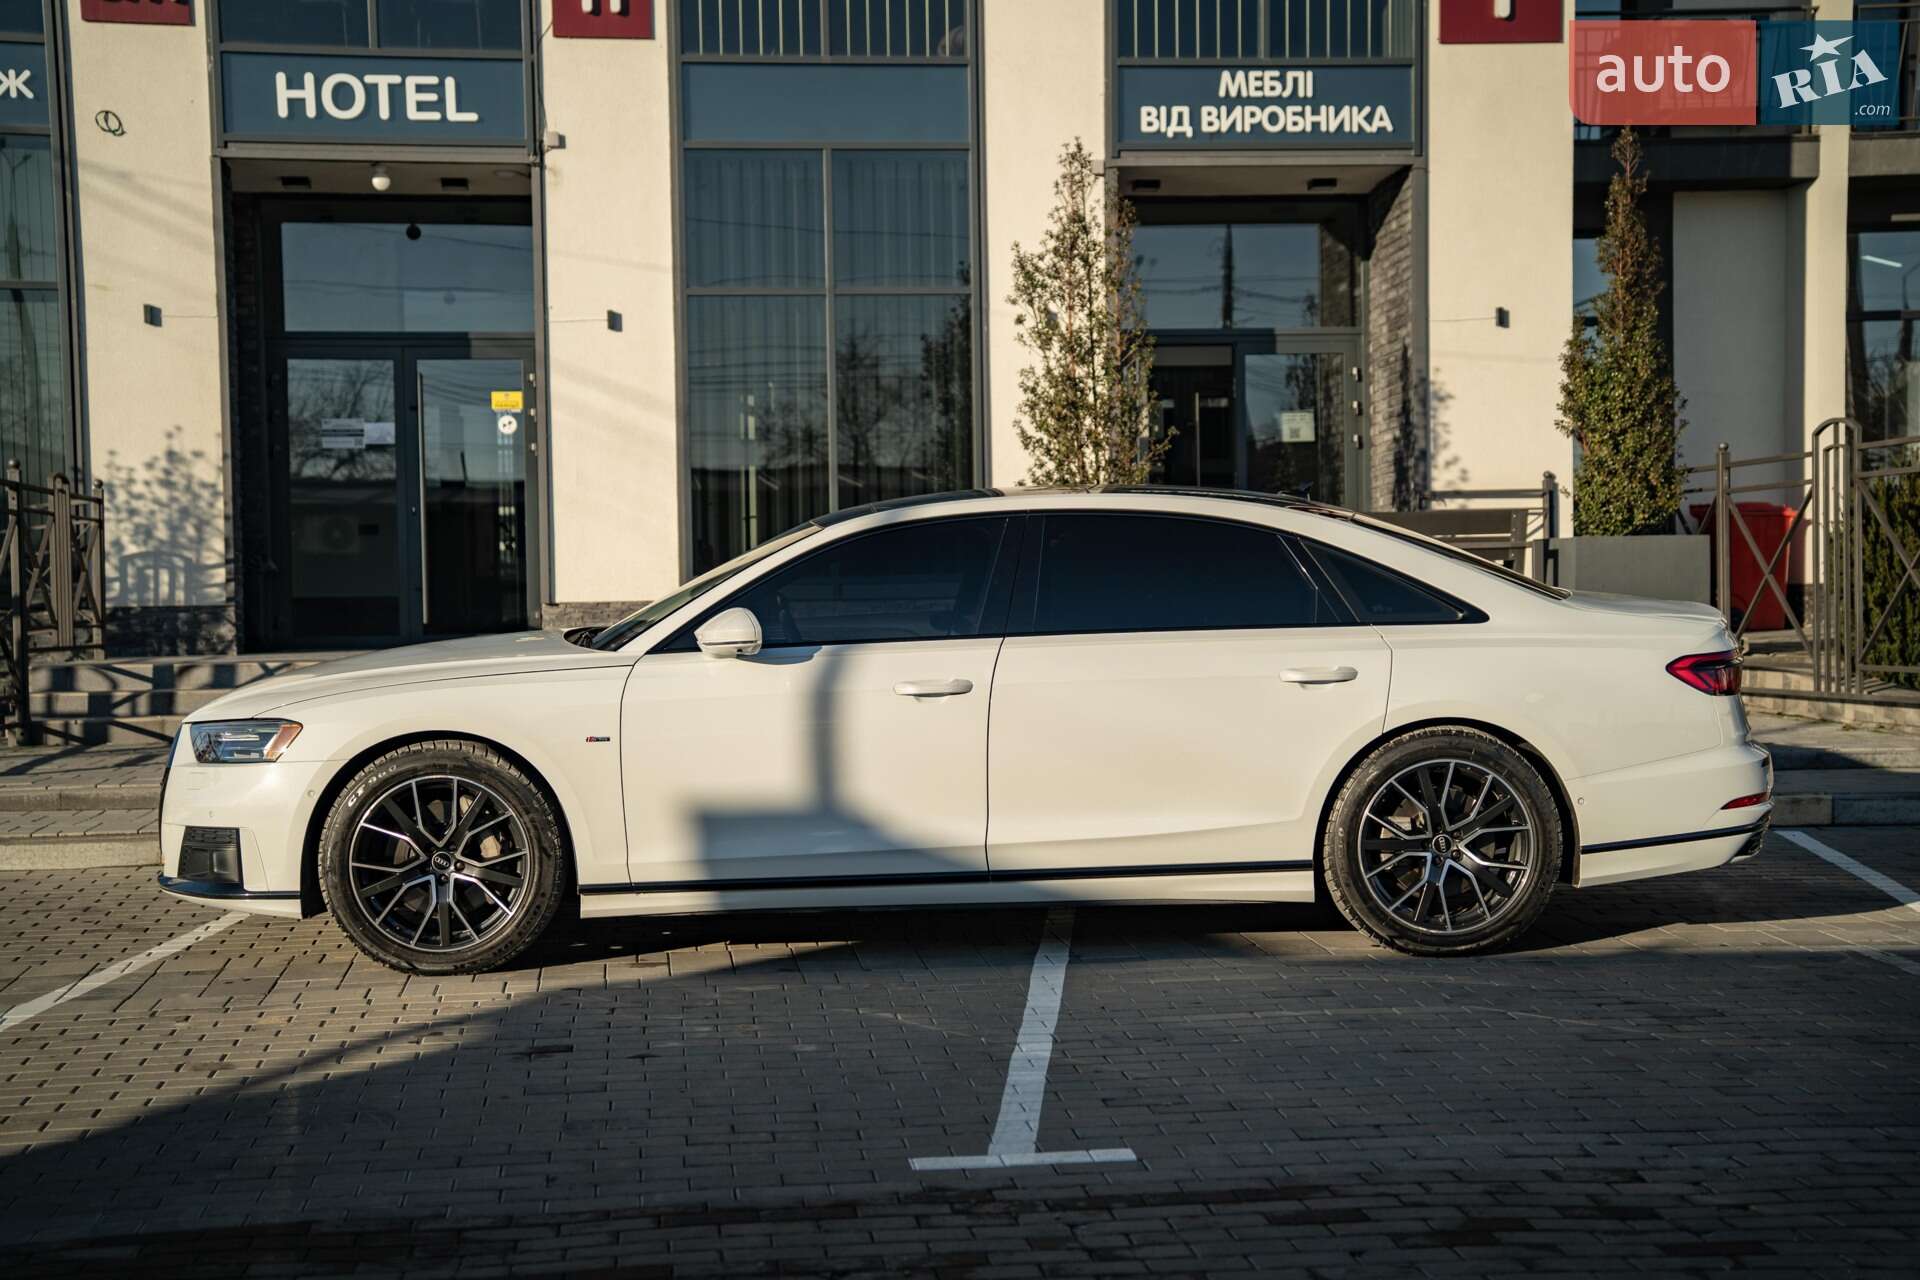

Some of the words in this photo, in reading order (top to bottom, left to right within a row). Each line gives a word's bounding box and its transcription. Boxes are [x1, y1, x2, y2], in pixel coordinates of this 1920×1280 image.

[275, 71, 479, 122] HOTEL
[1218, 69, 1314, 98] МЕБЛІ
[1140, 105, 1193, 138] ВІД
[1200, 104, 1394, 133] ВИРОБНИКА
